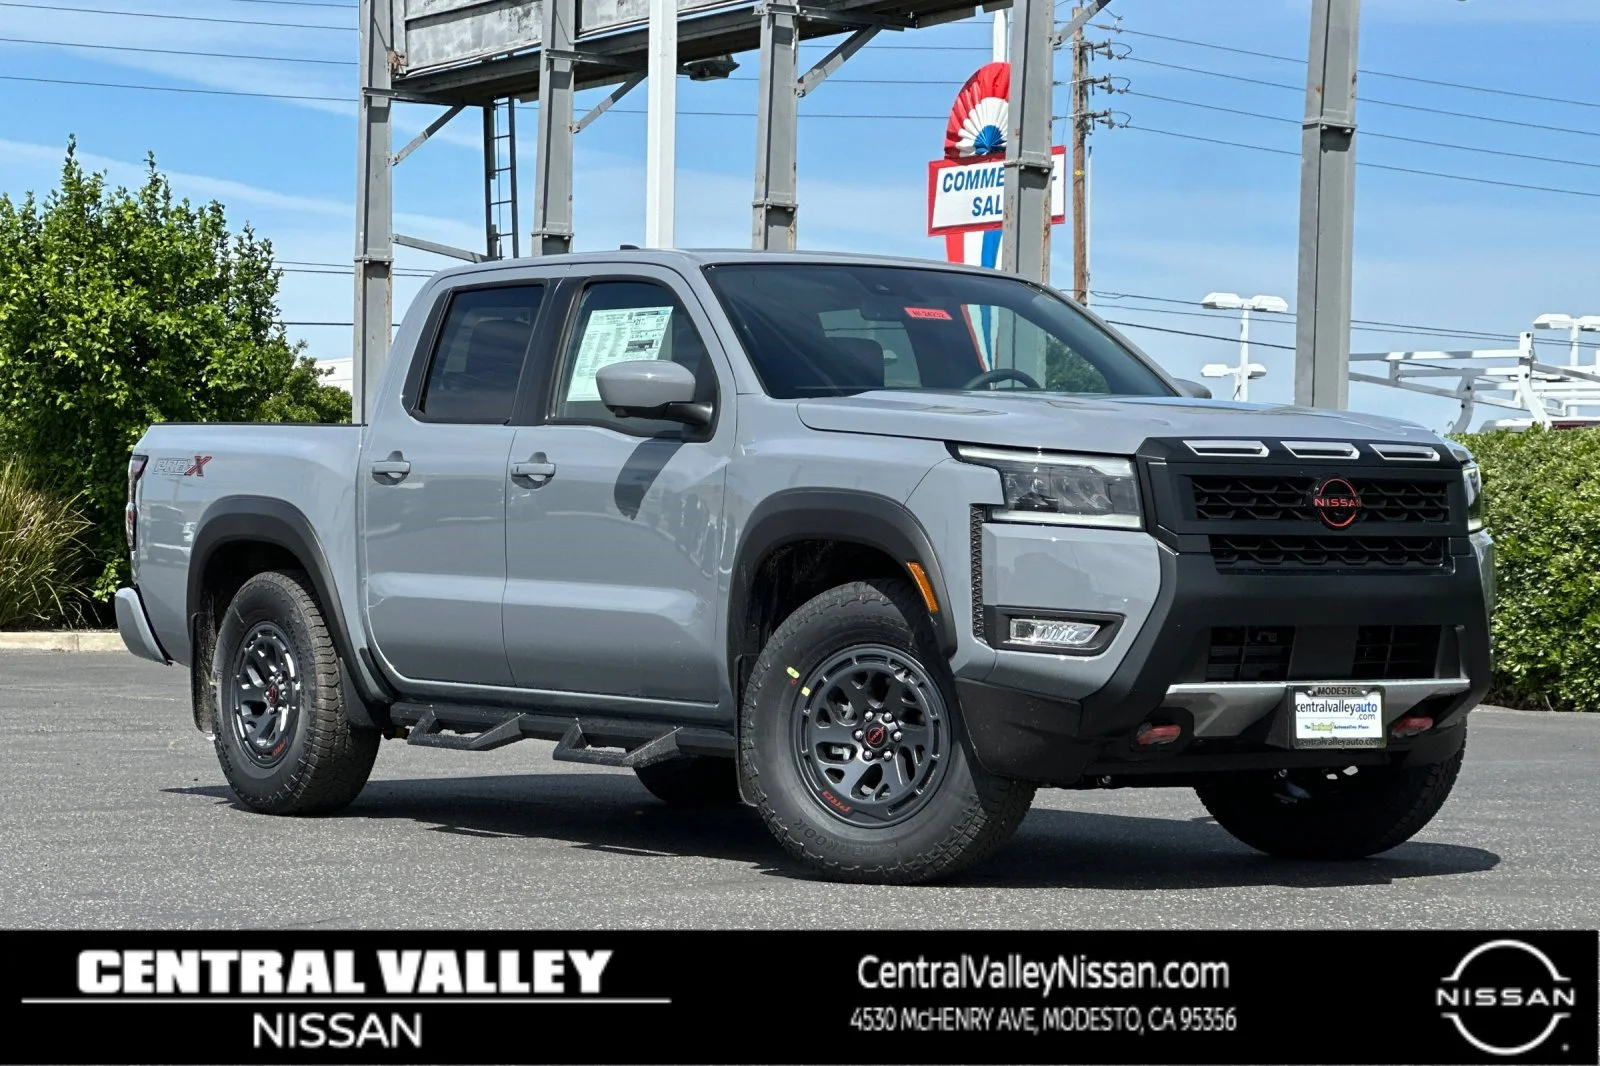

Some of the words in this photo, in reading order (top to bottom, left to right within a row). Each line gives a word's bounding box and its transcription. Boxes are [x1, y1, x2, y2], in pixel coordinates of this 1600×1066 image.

[971, 194, 1004, 217] SAL
[1314, 498, 1362, 507] NISSAN
[1296, 699, 1378, 716] centralvalleyauto
[1356, 713, 1376, 721] .com
